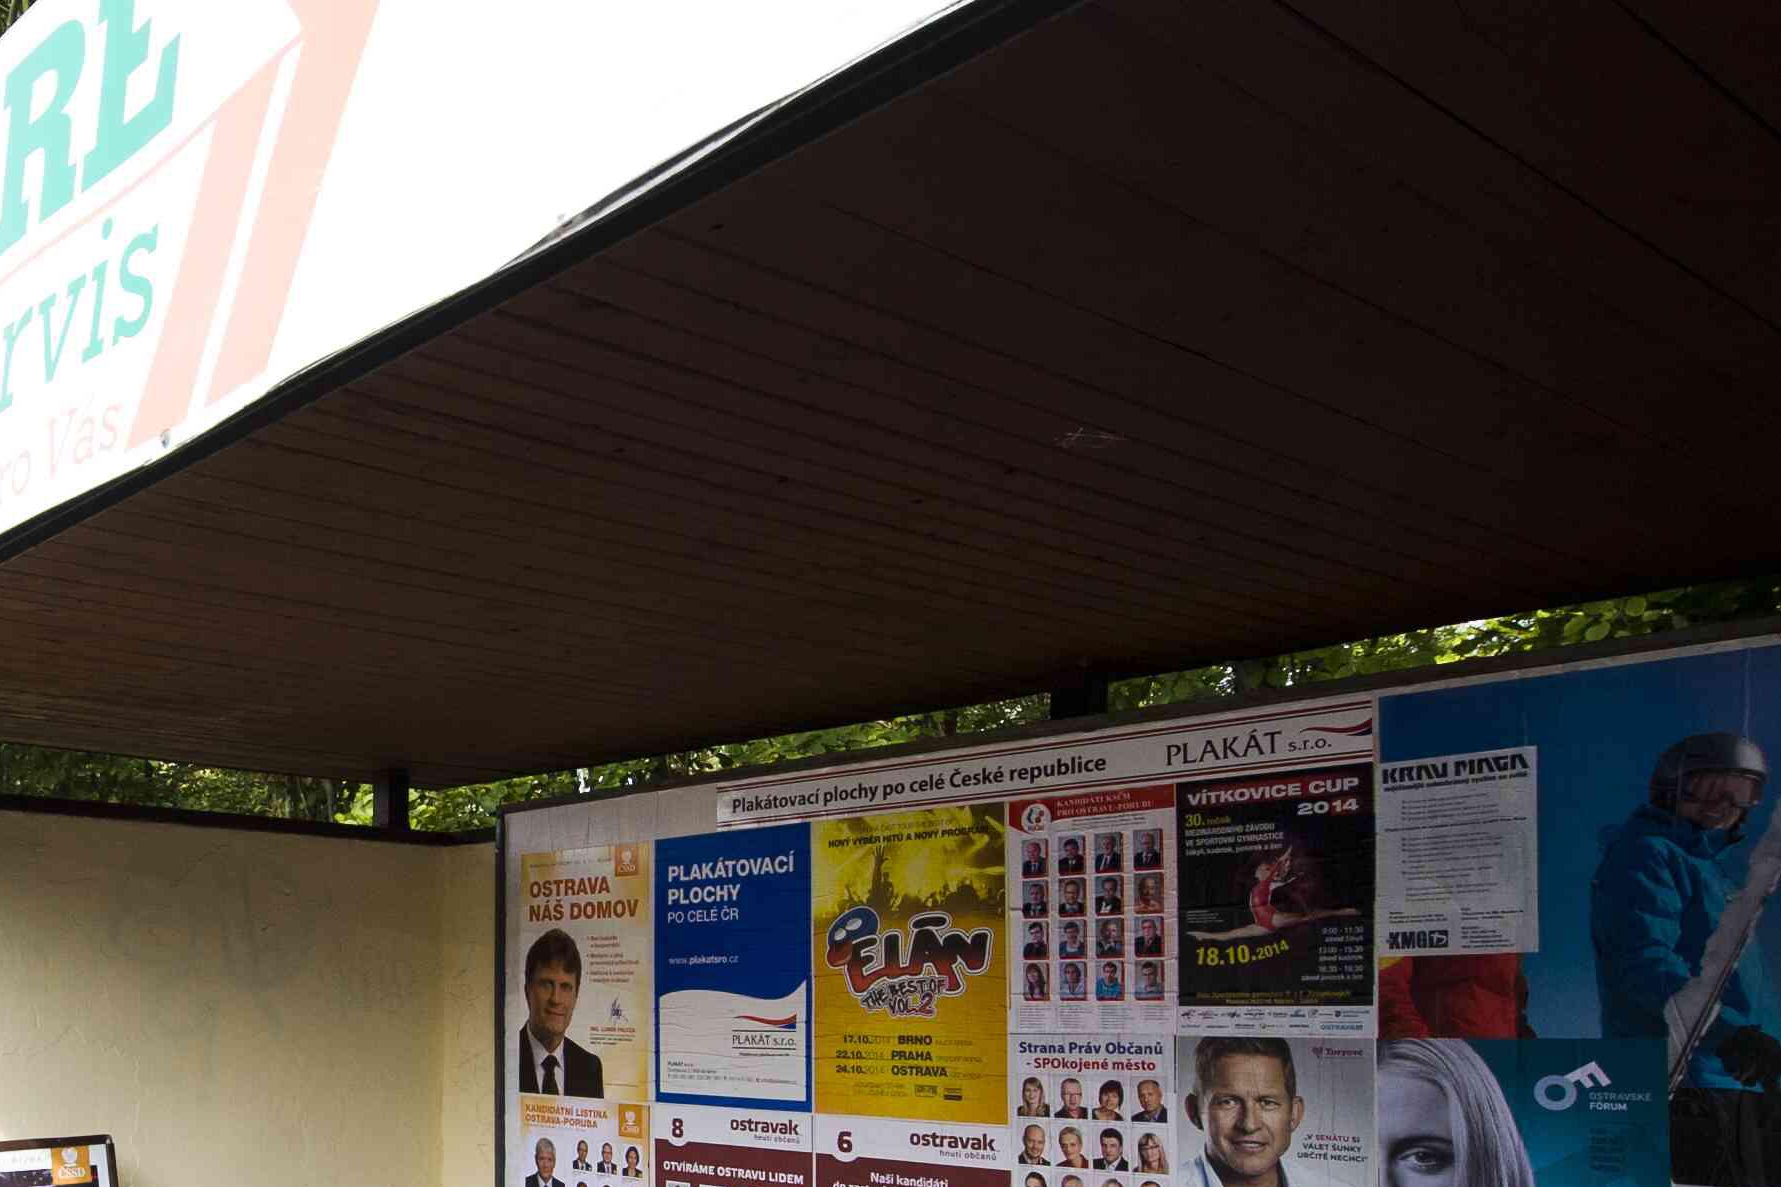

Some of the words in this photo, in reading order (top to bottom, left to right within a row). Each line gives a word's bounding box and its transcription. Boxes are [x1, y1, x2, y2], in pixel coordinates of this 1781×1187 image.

[46, 392, 123, 480] Vás
[1166, 730, 1282, 766] PLAKÁT
[1288, 737, 1332, 752] s.r.o.
[1382, 762, 1448, 785] KRAV
[731, 786, 820, 814] Plakátovací
[823, 782, 880, 808] plochy
[882, 779, 905, 802] po
[909, 774, 945, 793] celé
[949, 767, 1004, 790] České
[1009, 755, 1107, 785] republice
[1187, 782, 1303, 806] VÍTKOVICE
[1309, 777, 1360, 794] CUP
[1296, 798, 1359, 815] 2014
[828, 838, 849, 848] NOVÝ
[852, 834, 881, 847] VÝBĚR
[914, 830, 939, 841] NOVÝ
[667, 850, 795, 882] PLAKÁTOVACÍ
[529, 875, 610, 898] OSTRAVA
[667, 883, 741, 905] PLOCHY
[529, 899, 565, 922] NÁŠ
[570, 898, 639, 921] DOMOV
[667, 911, 684, 924] PO
[687, 906, 718, 922] CELÉ
[721, 905, 739, 921] ČR
[845, 912, 994, 996] ELÁN
[1196, 938, 1290, 966] 18.10.2014
[889, 979, 927, 995] BEST
[898, 1034, 933, 1046] BRNO
[1019, 1041, 1066, 1055] Strana
[1068, 1041, 1102, 1055] Práv
[1105, 1041, 1163, 1055] Občanů
[891, 1050, 933, 1062] PRAHA
[1034, 1056, 1109, 1073] SPOkojené
[1112, 1059, 1156, 1071] město
[892, 1065, 948, 1078] OSTRAVA
[525, 1103, 573, 1117] KANDIDÁTNÍ
[575, 1108, 608, 1119] LISTINA
[525, 1113, 598, 1129] OSTRAVA-PORUBA
[672, 1117, 684, 1138] 8
[730, 1117, 799, 1136] ostravak
[837, 1131, 853, 1153] 6
[909, 1132, 996, 1151] ostravak
[964, 1150, 997, 1161] občanů
[662, 1160, 715, 1176] OTVÍRÁME
[717, 1166, 766, 1182] OSTRAVU
[769, 1172, 804, 1185] LIDEM
[870, 1171, 894, 1185] Naši
